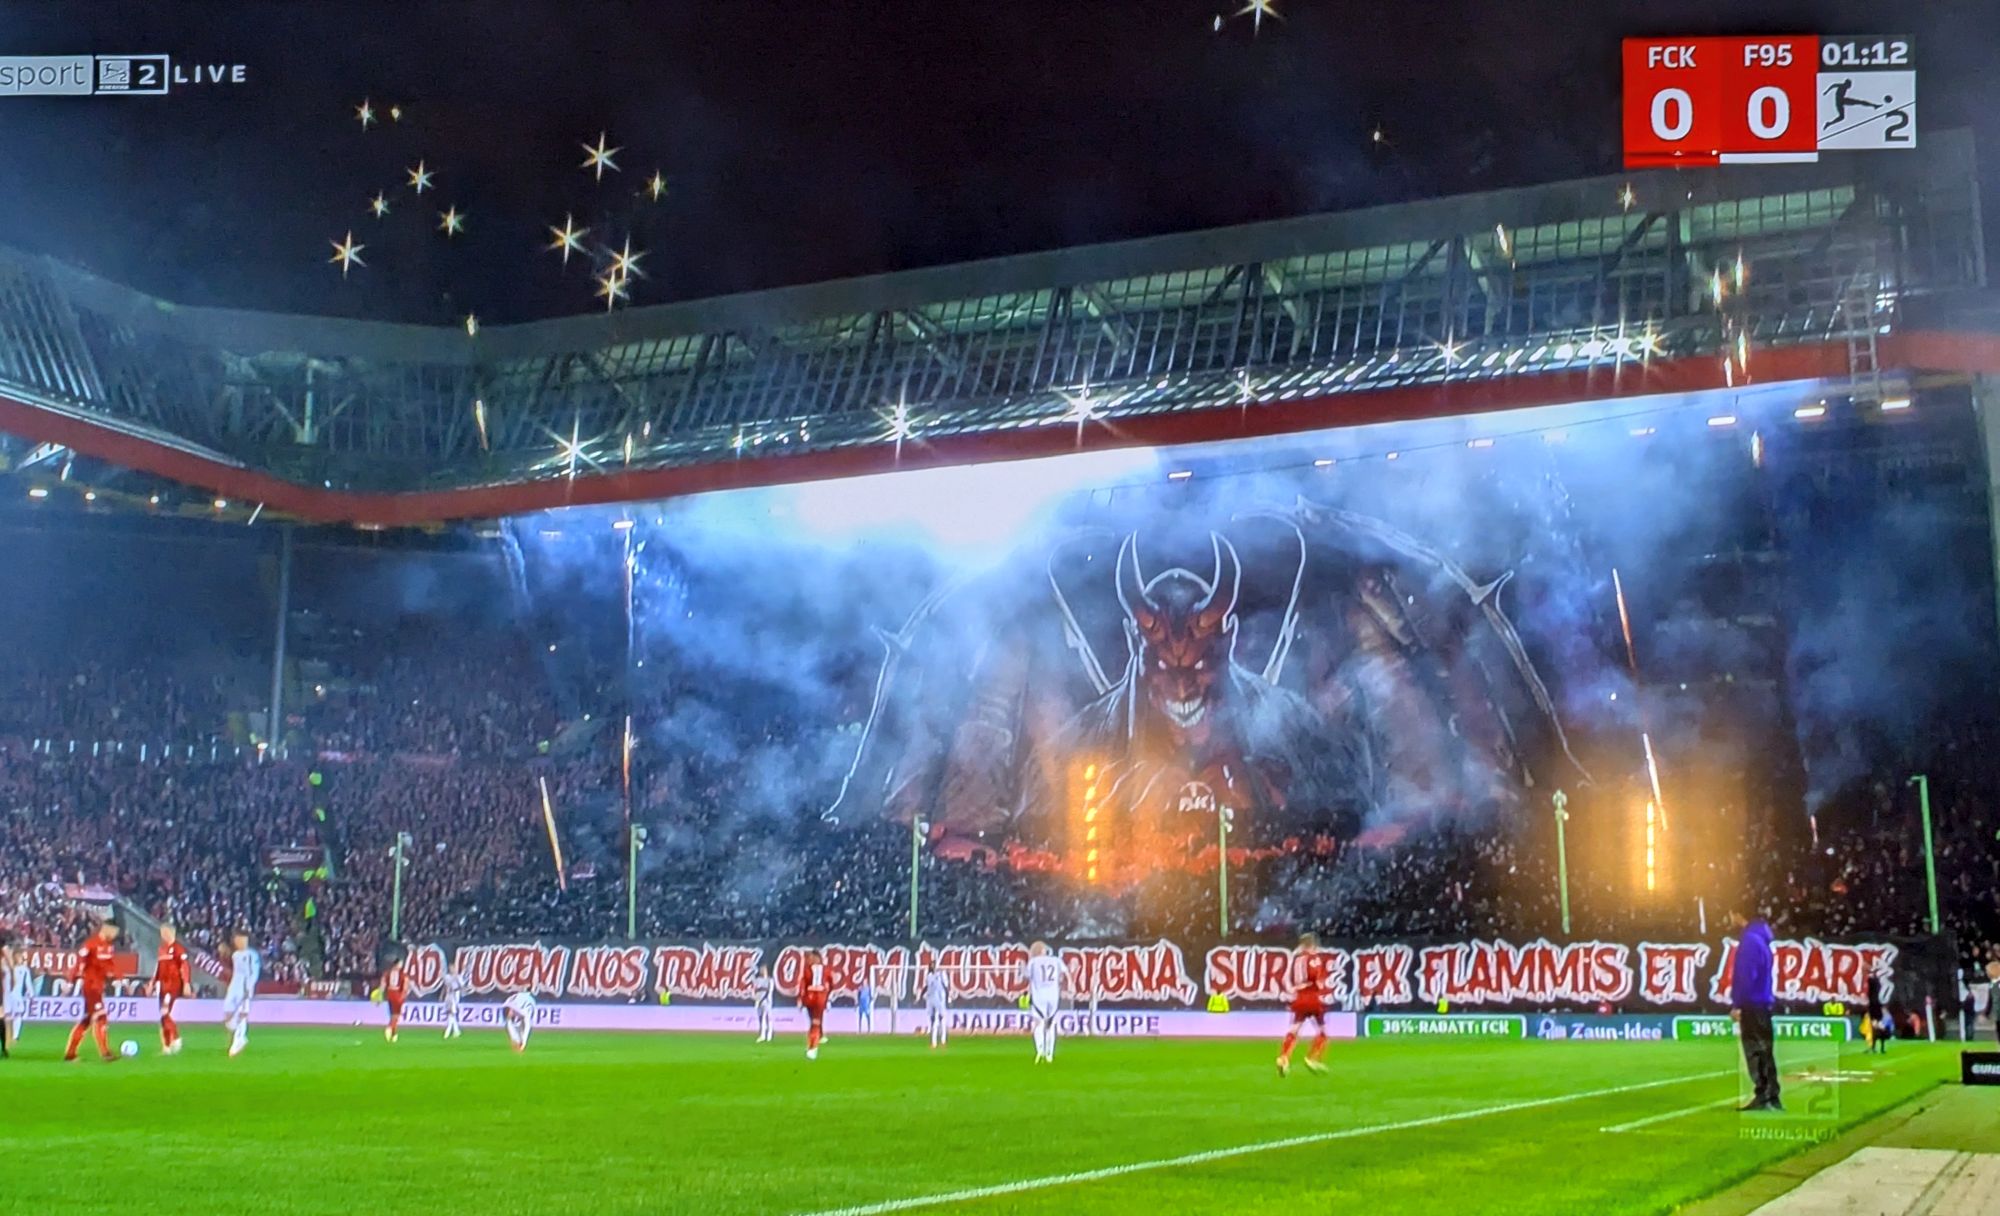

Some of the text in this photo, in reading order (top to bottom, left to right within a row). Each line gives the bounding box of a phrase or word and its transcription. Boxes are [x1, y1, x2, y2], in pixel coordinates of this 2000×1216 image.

[404, 945, 445, 997] AD
[569, 945, 649, 997] NOS
[655, 944, 761, 998] TRAHE
[774, 945, 908, 999] OBEM
[914, 942, 1032, 999] MUND
[1354, 946, 1412, 1001] EX
[1639, 944, 1709, 1002] ET
[1041, 964, 1055, 982] 12
[1571, 1022, 1662, 1040] Zaun-Idee
